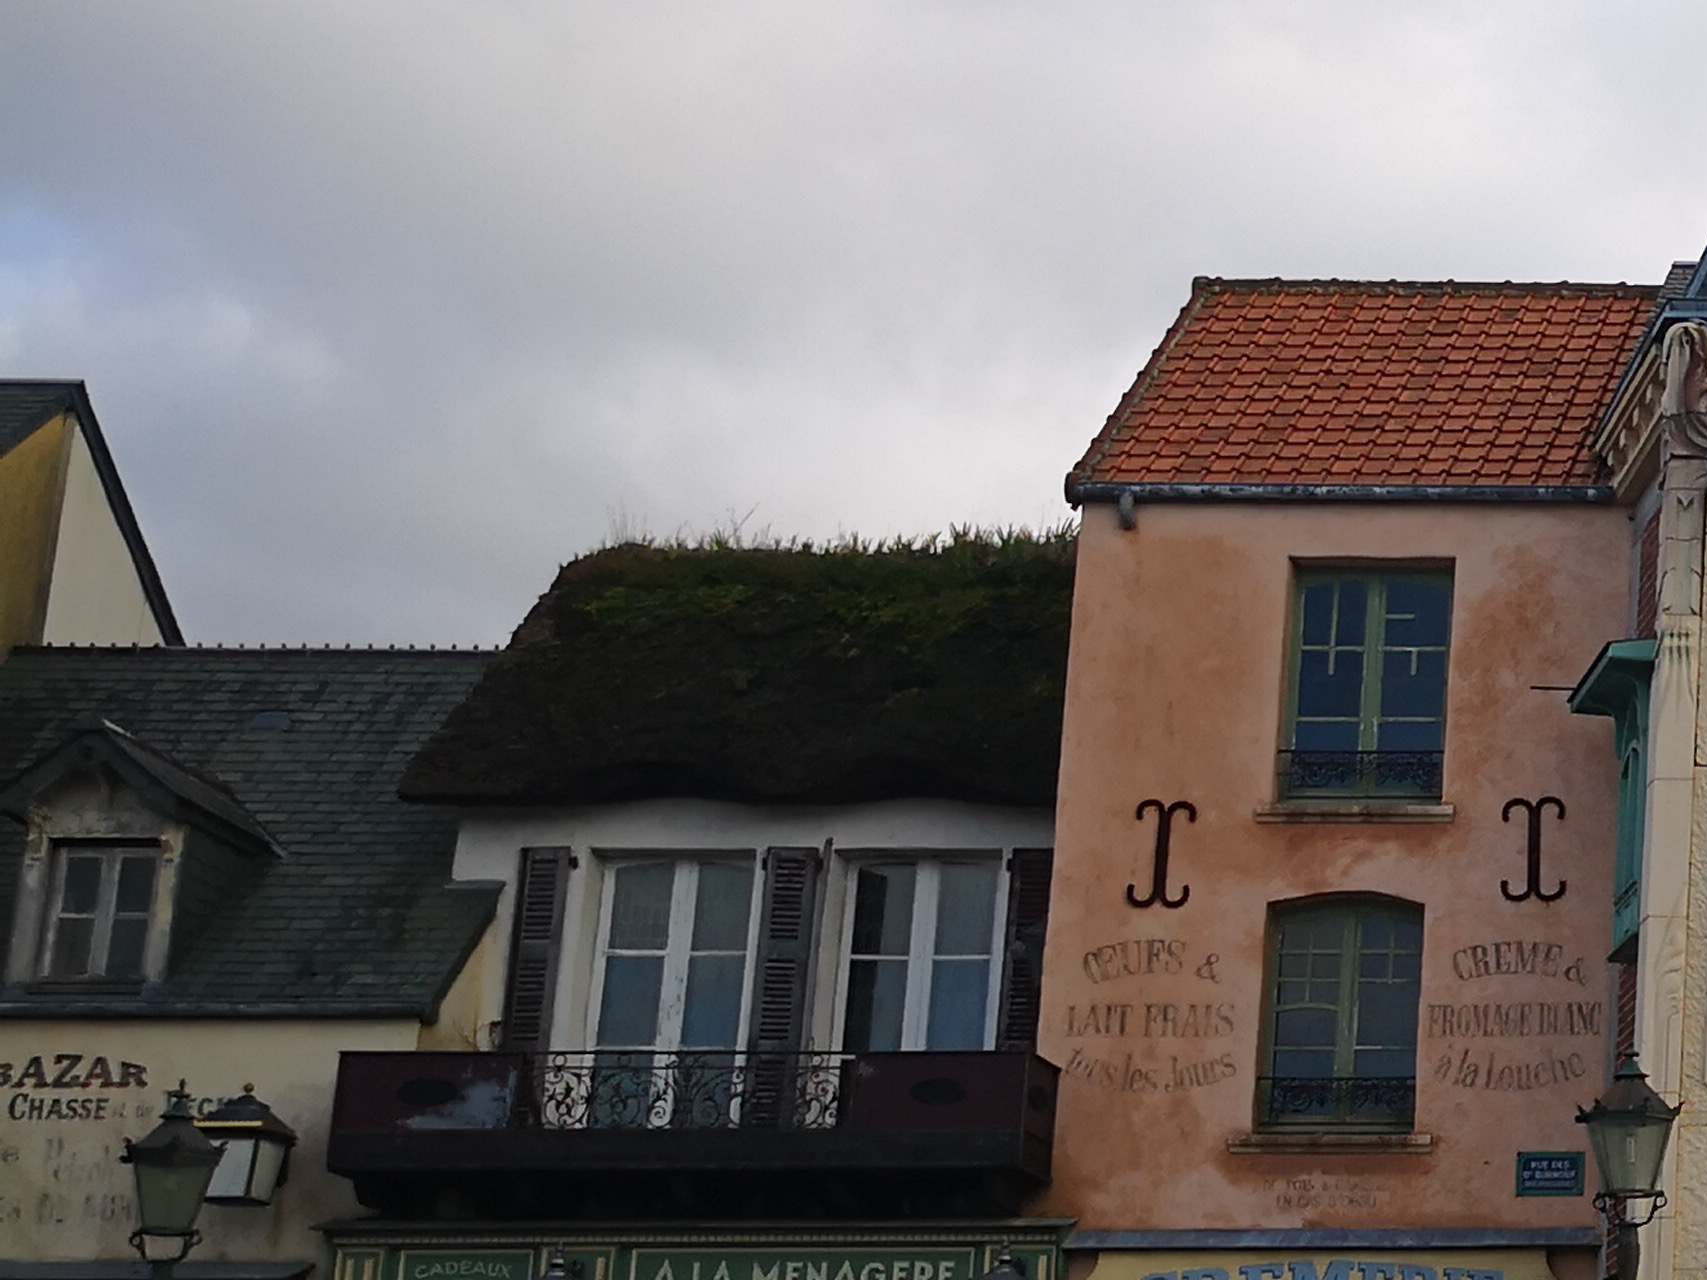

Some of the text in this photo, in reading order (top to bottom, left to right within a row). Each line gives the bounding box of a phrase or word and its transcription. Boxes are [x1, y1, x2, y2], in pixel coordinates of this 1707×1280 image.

[1194, 952, 1221, 984] &
[1453, 939, 1587, 987] CREME &
[1065, 1002, 1236, 1039] LAIT FRAIS
[1428, 1001, 1602, 1039] FROMAGE BLANC
[8, 1093, 110, 1121] CHASSE
[414, 1260, 512, 1280] CADEAUX
